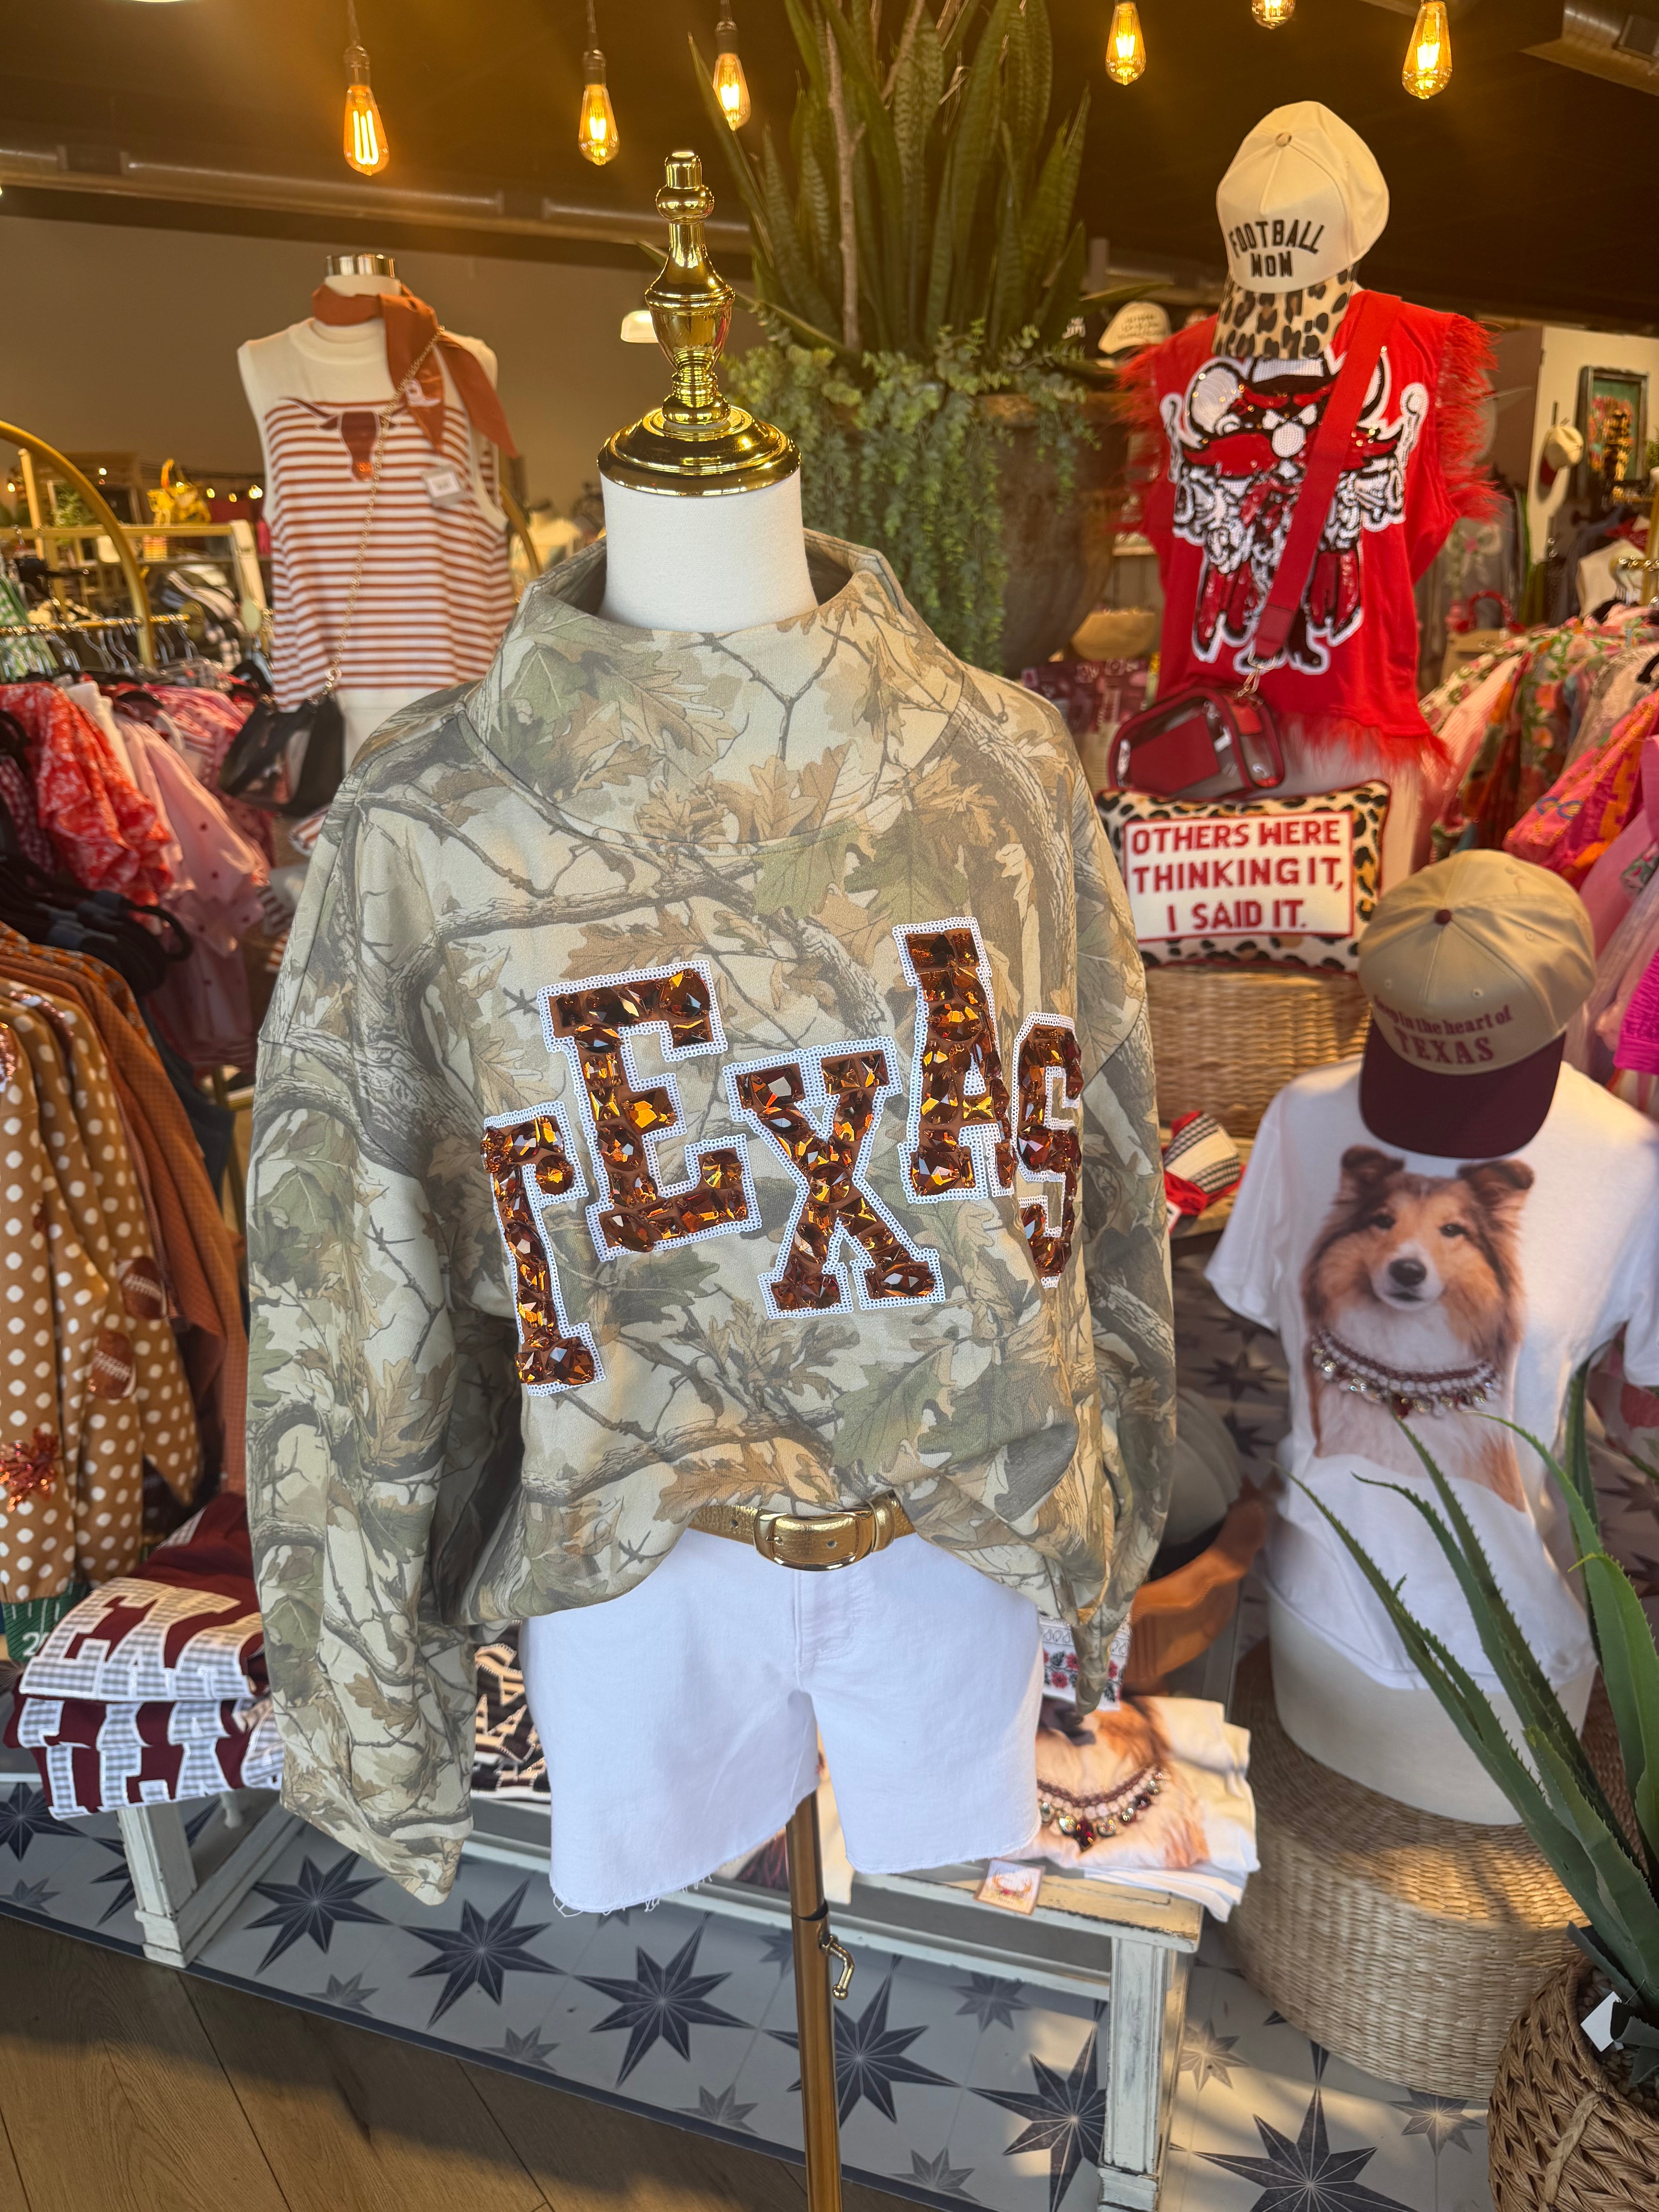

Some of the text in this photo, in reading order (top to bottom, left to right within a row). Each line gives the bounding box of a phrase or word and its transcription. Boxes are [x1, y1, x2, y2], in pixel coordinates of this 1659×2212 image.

[1228, 219, 1325, 259] FOOTBALL
[1250, 251, 1293, 277] MOM
[1132, 819, 1341, 855] OTHERS WERE
[1132, 857, 1343, 894] THINKING IT,
[1166, 899, 1307, 932] I SAID IT.
[1415, 1018, 1442, 1034] the
[1442, 1014, 1493, 1036] heart
[1494, 1005, 1513, 1025] of
[1393, 1026, 1494, 1065] TEXAS
[481, 916, 1084, 1396] TEXAS
